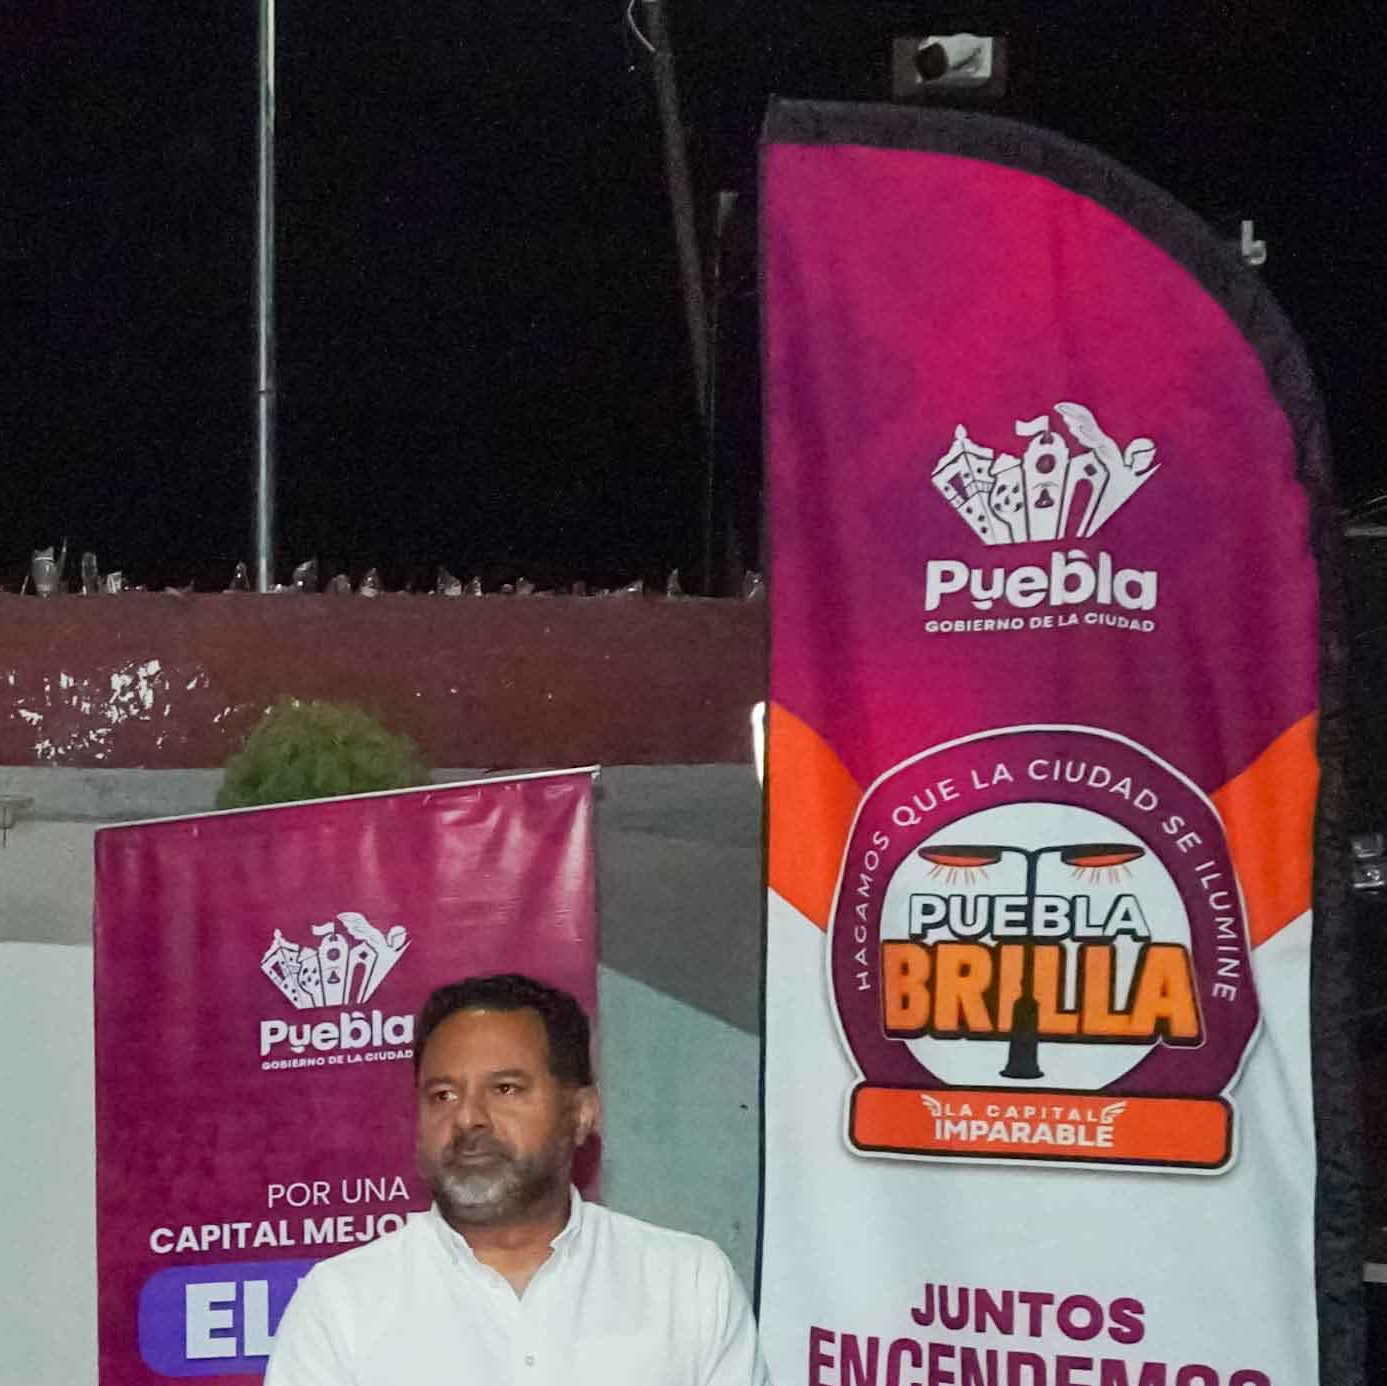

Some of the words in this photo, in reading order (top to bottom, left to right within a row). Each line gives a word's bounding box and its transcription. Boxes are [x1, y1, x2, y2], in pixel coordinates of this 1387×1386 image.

[924, 549, 1157, 611] Puebla
[925, 617, 1024, 633] GOBIERNO
[1029, 615, 1053, 629] DE
[1058, 613, 1079, 627] LA
[1084, 612, 1155, 632] CIUDAD
[856, 831, 889, 991] HAGAMOS
[892, 779, 960, 828] QUE
[970, 763, 1014, 790] LA
[1028, 759, 1158, 812] CIUDAD
[1161, 814, 1203, 854] SE
[1194, 860, 1241, 1002] ILUMINE
[909, 893, 1152, 940] PUEBLA
[882, 939, 1204, 1049] BRILLA
[260, 1009, 415, 1057] Puebla
[261, 1057, 325, 1071] GOBIERNO
[328, 1055, 344, 1065] DE
[347, 1053, 362, 1064] LA
[365, 1050, 414, 1062] CIUDAD
[934, 1119, 1115, 1148] IMPARABLE
[945, 1103, 974, 1117] LA
[986, 1104, 1098, 1122] CAPITAL
[268, 1181, 331, 1208] POR
[341, 1176, 410, 1204] UNA
[150, 1218, 295, 1254] CAPITAL
[303, 1213, 411, 1246] MEJO
[911, 1282, 1145, 1345] JUNTOS
